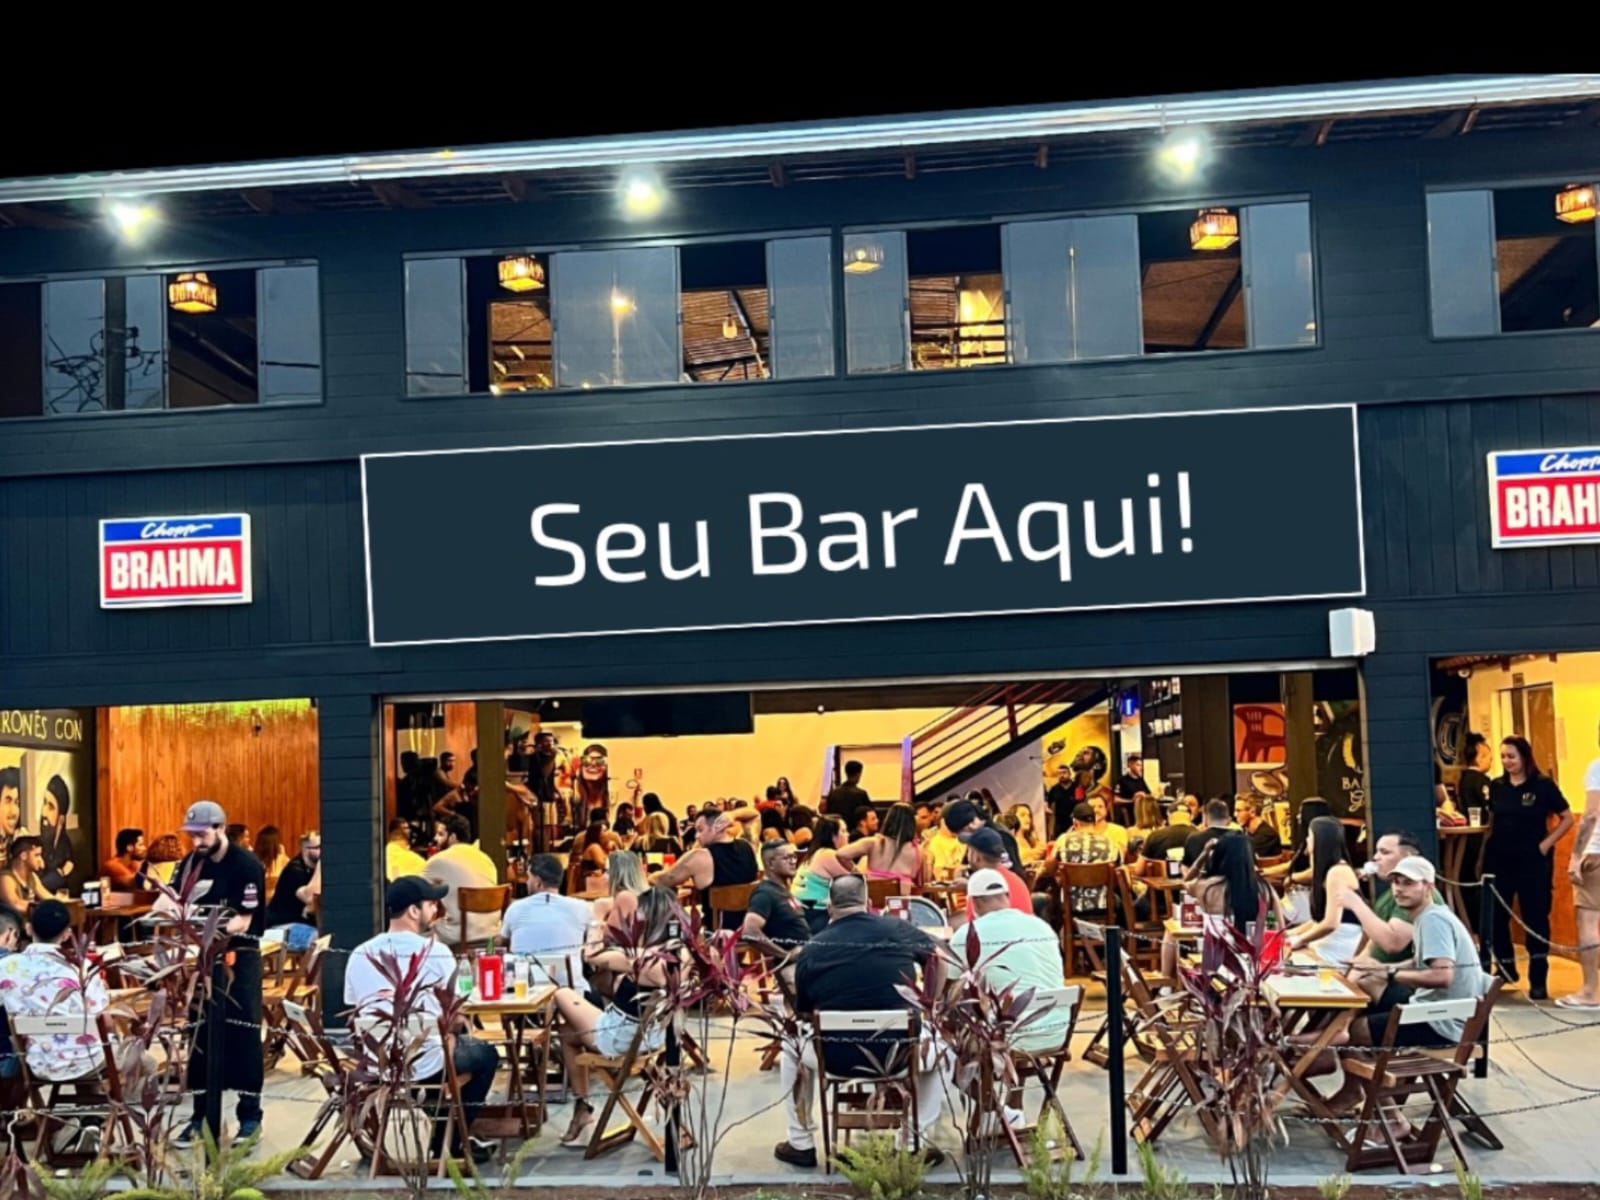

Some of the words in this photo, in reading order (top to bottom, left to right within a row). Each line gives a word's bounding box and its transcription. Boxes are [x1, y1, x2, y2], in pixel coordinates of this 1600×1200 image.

[1504, 482, 1600, 529] BRAH
[530, 502, 710, 587] Seu
[749, 492, 919, 576] Bar
[944, 471, 1195, 582] Aqui!
[109, 546, 236, 591] BRAHMA
[54, 717, 83, 743] CON
